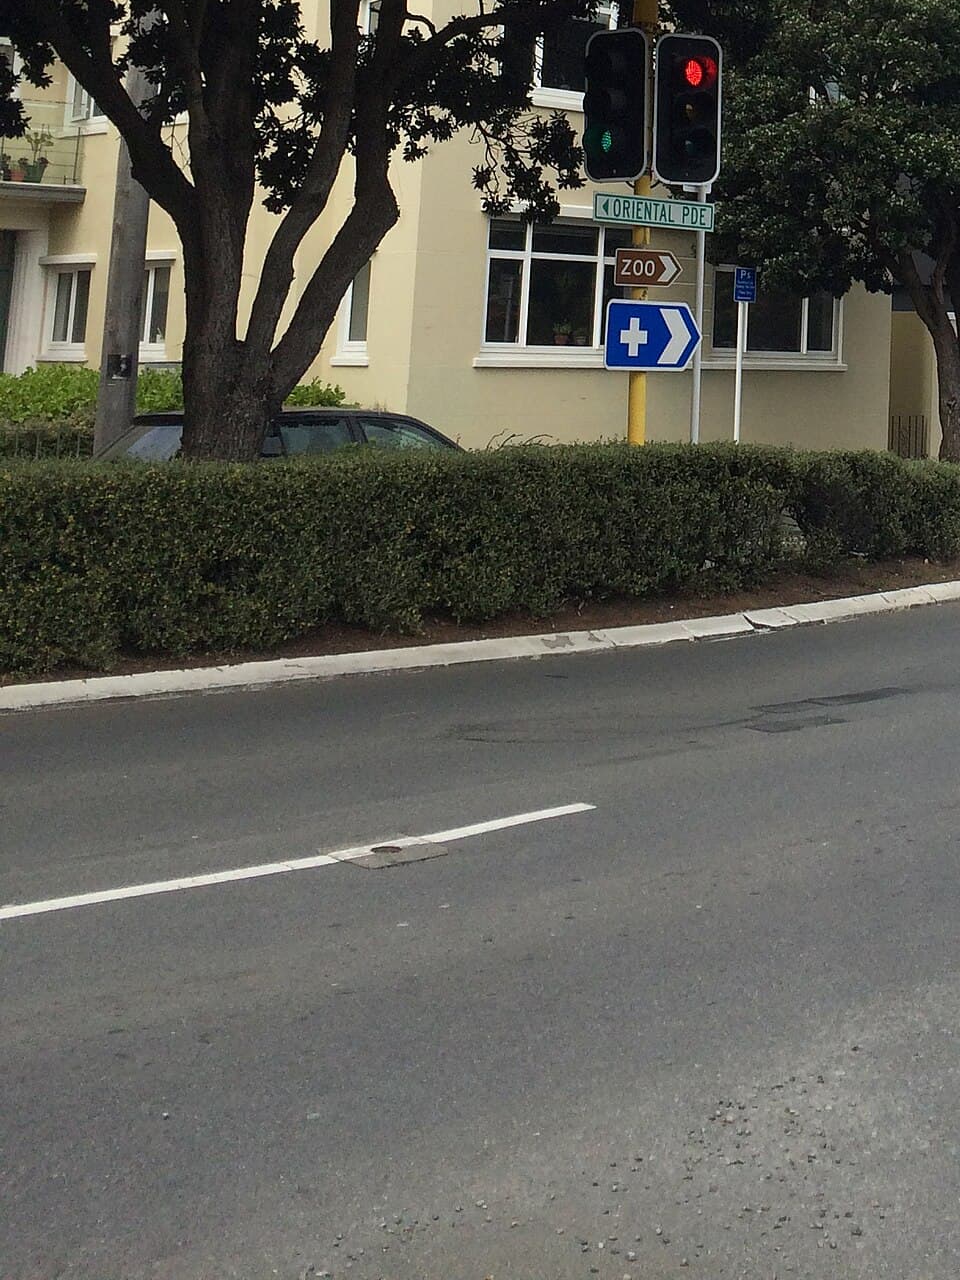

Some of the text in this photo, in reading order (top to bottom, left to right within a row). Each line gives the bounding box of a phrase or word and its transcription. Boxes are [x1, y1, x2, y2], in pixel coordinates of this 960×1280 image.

[613, 199, 707, 226] ORIENTAL PDE
[621, 259, 656, 276] ZOO
